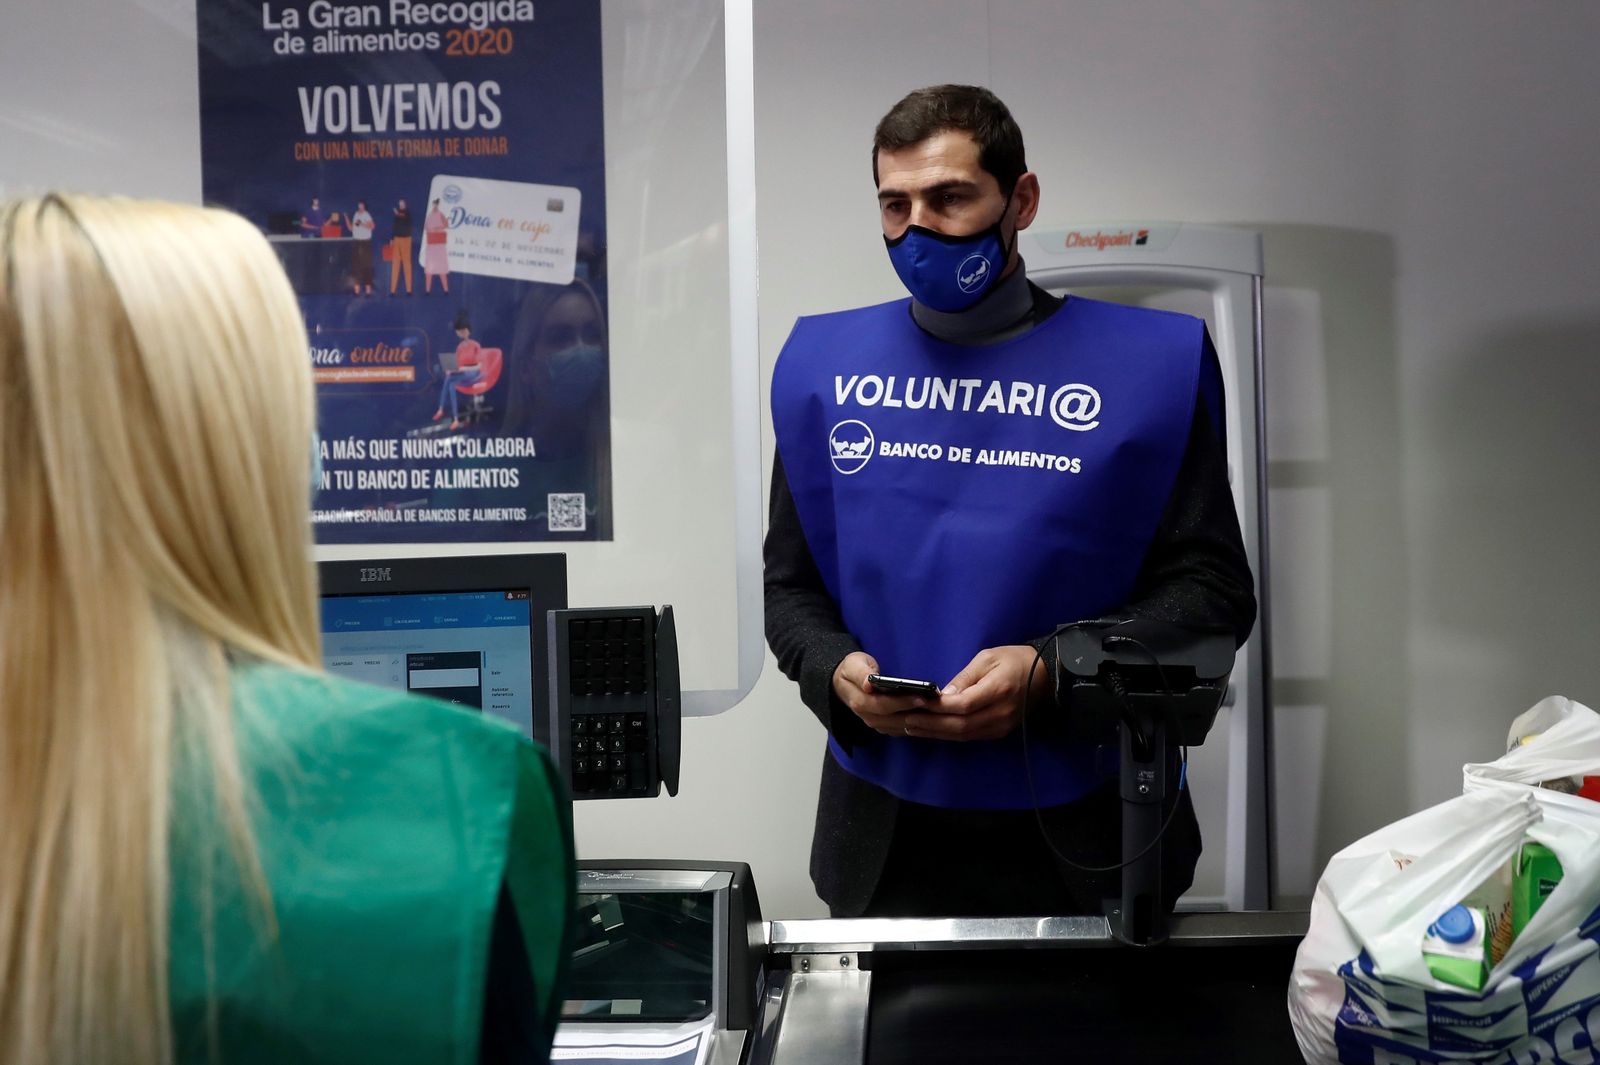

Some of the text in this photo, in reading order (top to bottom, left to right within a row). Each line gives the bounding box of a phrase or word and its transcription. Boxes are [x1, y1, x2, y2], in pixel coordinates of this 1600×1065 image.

[262, 0, 534, 31] La Gran Recogida
[273, 28, 513, 56] de alimentos 2020
[298, 80, 502, 134] VOLVEMOS
[294, 136, 508, 161] CON UNA NUEVA FORMA DE DONAR
[448, 206, 552, 242] Dona en caja
[1065, 229, 1134, 251] Checkpoint
[310, 341, 413, 364] ona online
[834, 375, 1101, 431] VOLUNTARI@
[332, 435, 366, 460] MÁS
[369, 439, 398, 461] QUE
[402, 438, 453, 459] NUNCA
[457, 437, 536, 458] COLABORA
[879, 441, 1082, 474] BANCO DE ALIMENTOS
[334, 470, 353, 490] TU
[357, 469, 408, 490] BANCO
[411, 469, 431, 489] DE
[434, 468, 519, 489] ALIMENTOS
[354, 506, 401, 523] ESPAÑOLA
[404, 509, 416, 522] DE
[418, 508, 456, 523] BANCOS
[458, 508, 471, 522] DE
[473, 508, 526, 522] ALIMENTOS
[360, 567, 391, 582] IBM
[1527, 965, 1571, 1001] HIPERCOR
